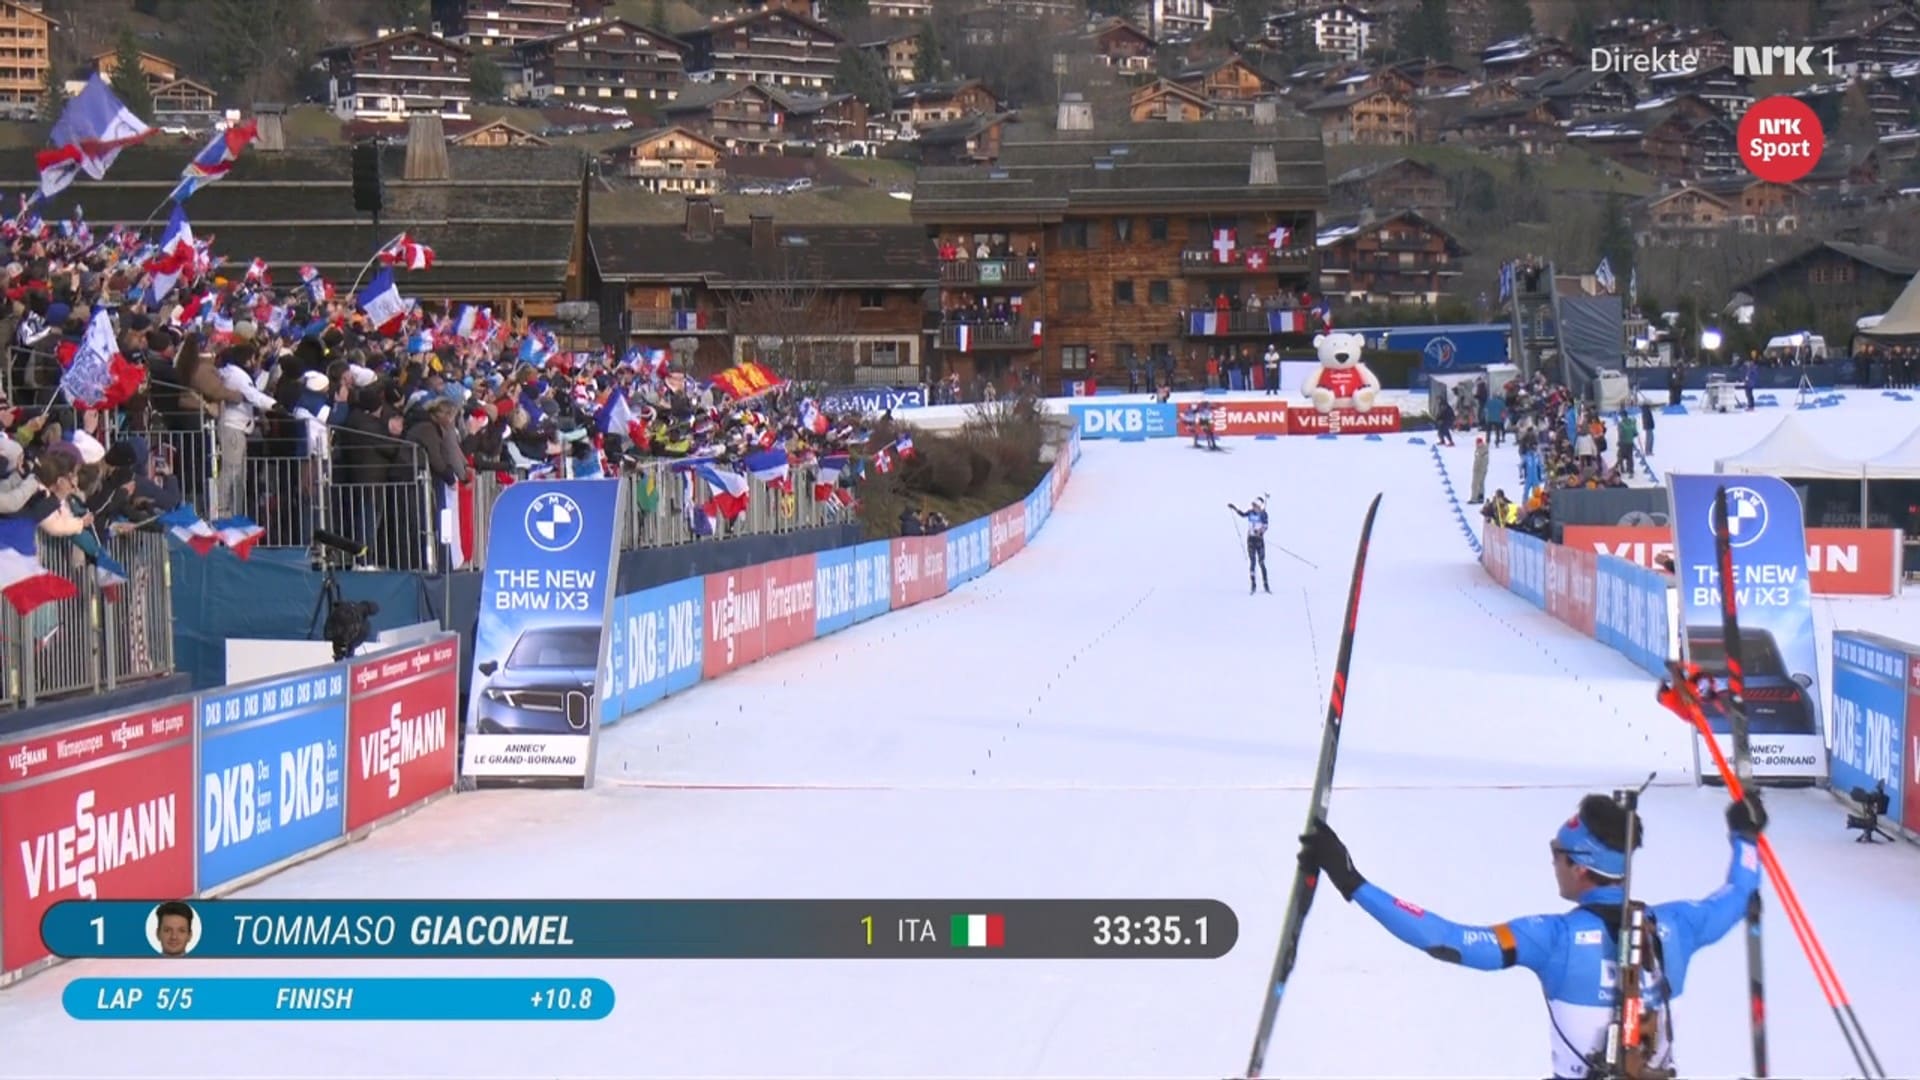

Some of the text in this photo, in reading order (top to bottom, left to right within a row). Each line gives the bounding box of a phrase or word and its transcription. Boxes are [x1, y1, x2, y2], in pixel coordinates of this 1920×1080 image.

[1084, 409, 1143, 433] DKB
[1298, 410, 1394, 433] VIESSMANN
[495, 569, 596, 589] THE NEW
[1745, 564, 1797, 584] NEW
[495, 591, 589, 611] BMW iX3
[1755, 587, 1789, 606] iX3
[668, 599, 693, 674] DKB
[628, 610, 657, 690] DKB
[205, 702, 221, 727] DKB
[225, 698, 240, 723] DKB
[244, 694, 259, 718] DKB
[263, 689, 277, 713] DKB
[280, 685, 294, 709] DKB
[1833, 692, 1855, 766] DKB
[360, 700, 446, 800] VIESSMANN
[504, 743, 547, 754] ANNECY
[1749, 744, 1785, 754] NNECY
[1865, 707, 1890, 785] DKB
[258, 759, 270, 782] Das
[474, 755, 577, 766] LE GRAND-BORNAND
[280, 742, 326, 827] DKB
[204, 762, 256, 854] DKB
[256, 808, 272, 835] Bank
